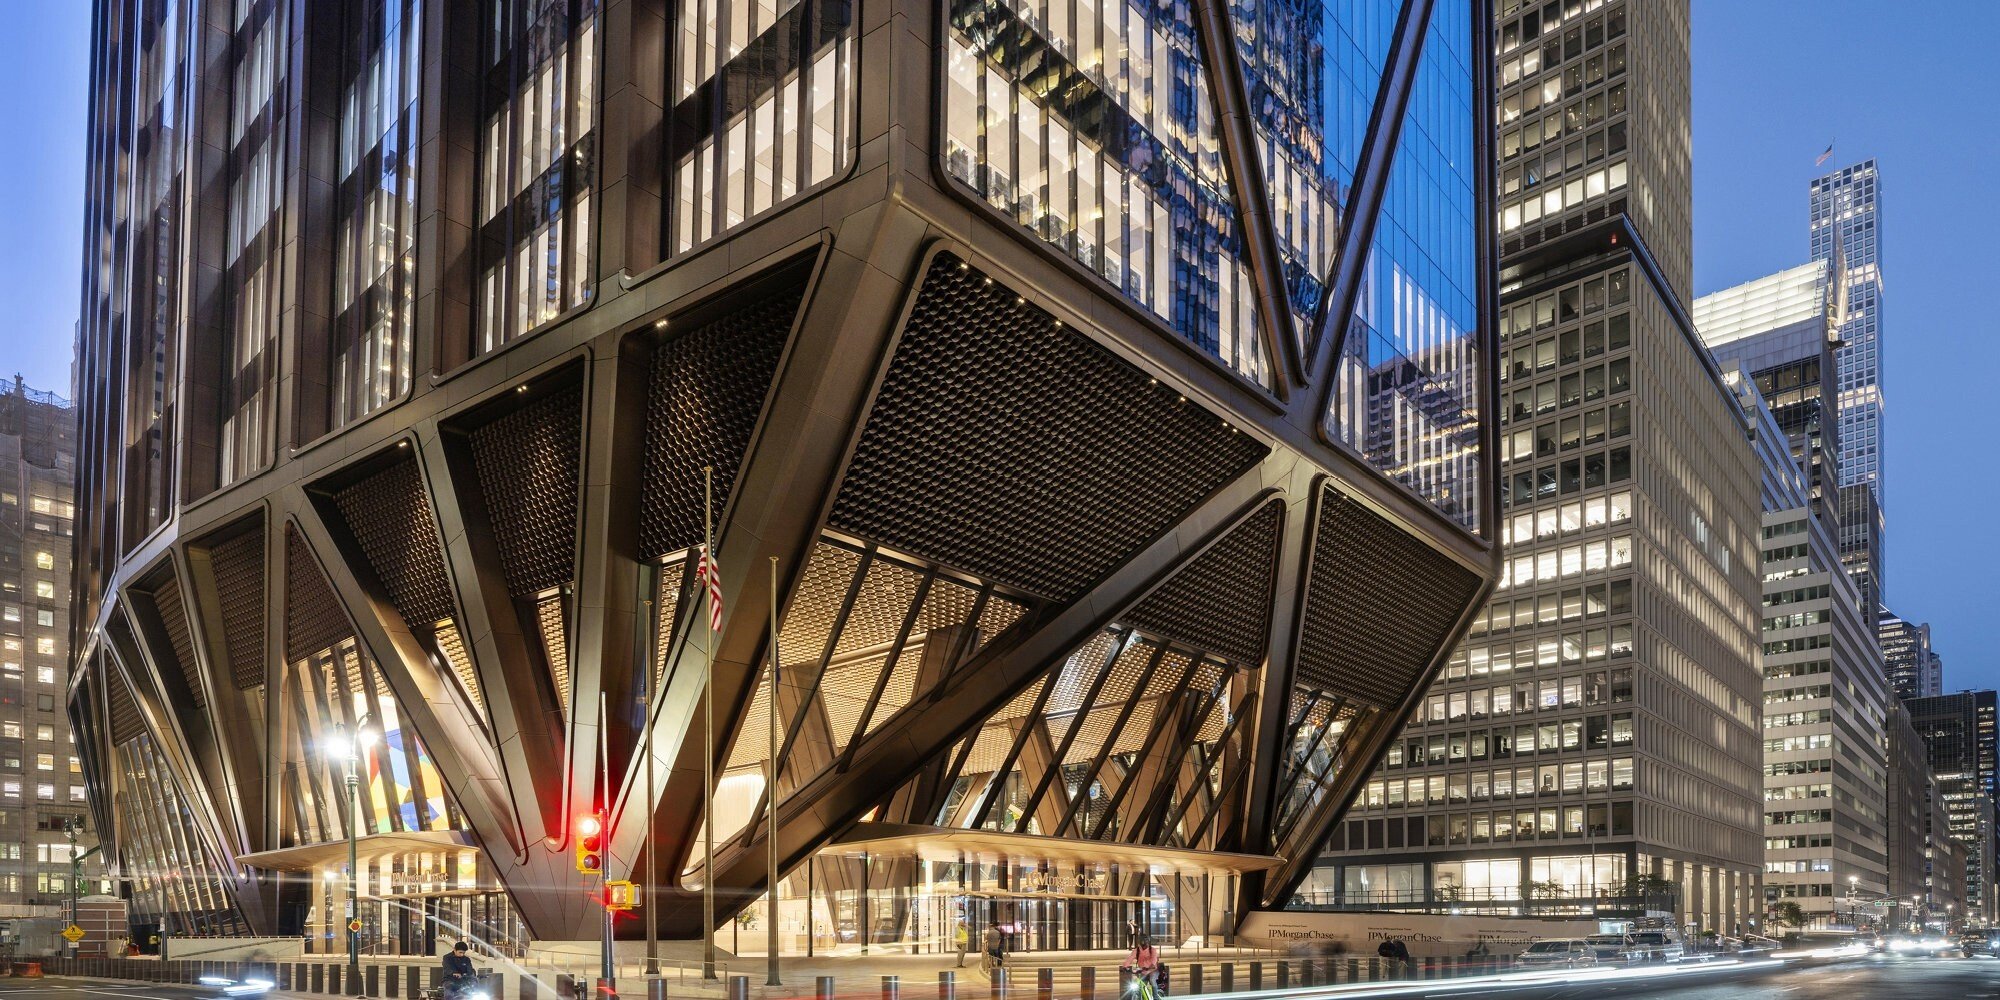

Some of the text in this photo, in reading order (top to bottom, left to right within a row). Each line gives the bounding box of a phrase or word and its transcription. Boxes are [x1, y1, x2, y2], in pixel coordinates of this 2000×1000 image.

[1025, 871, 1105, 891] JPMorganChase
[1268, 929, 1335, 940] JPMorganChase
[1367, 931, 1442, 943] JPMorganChase
